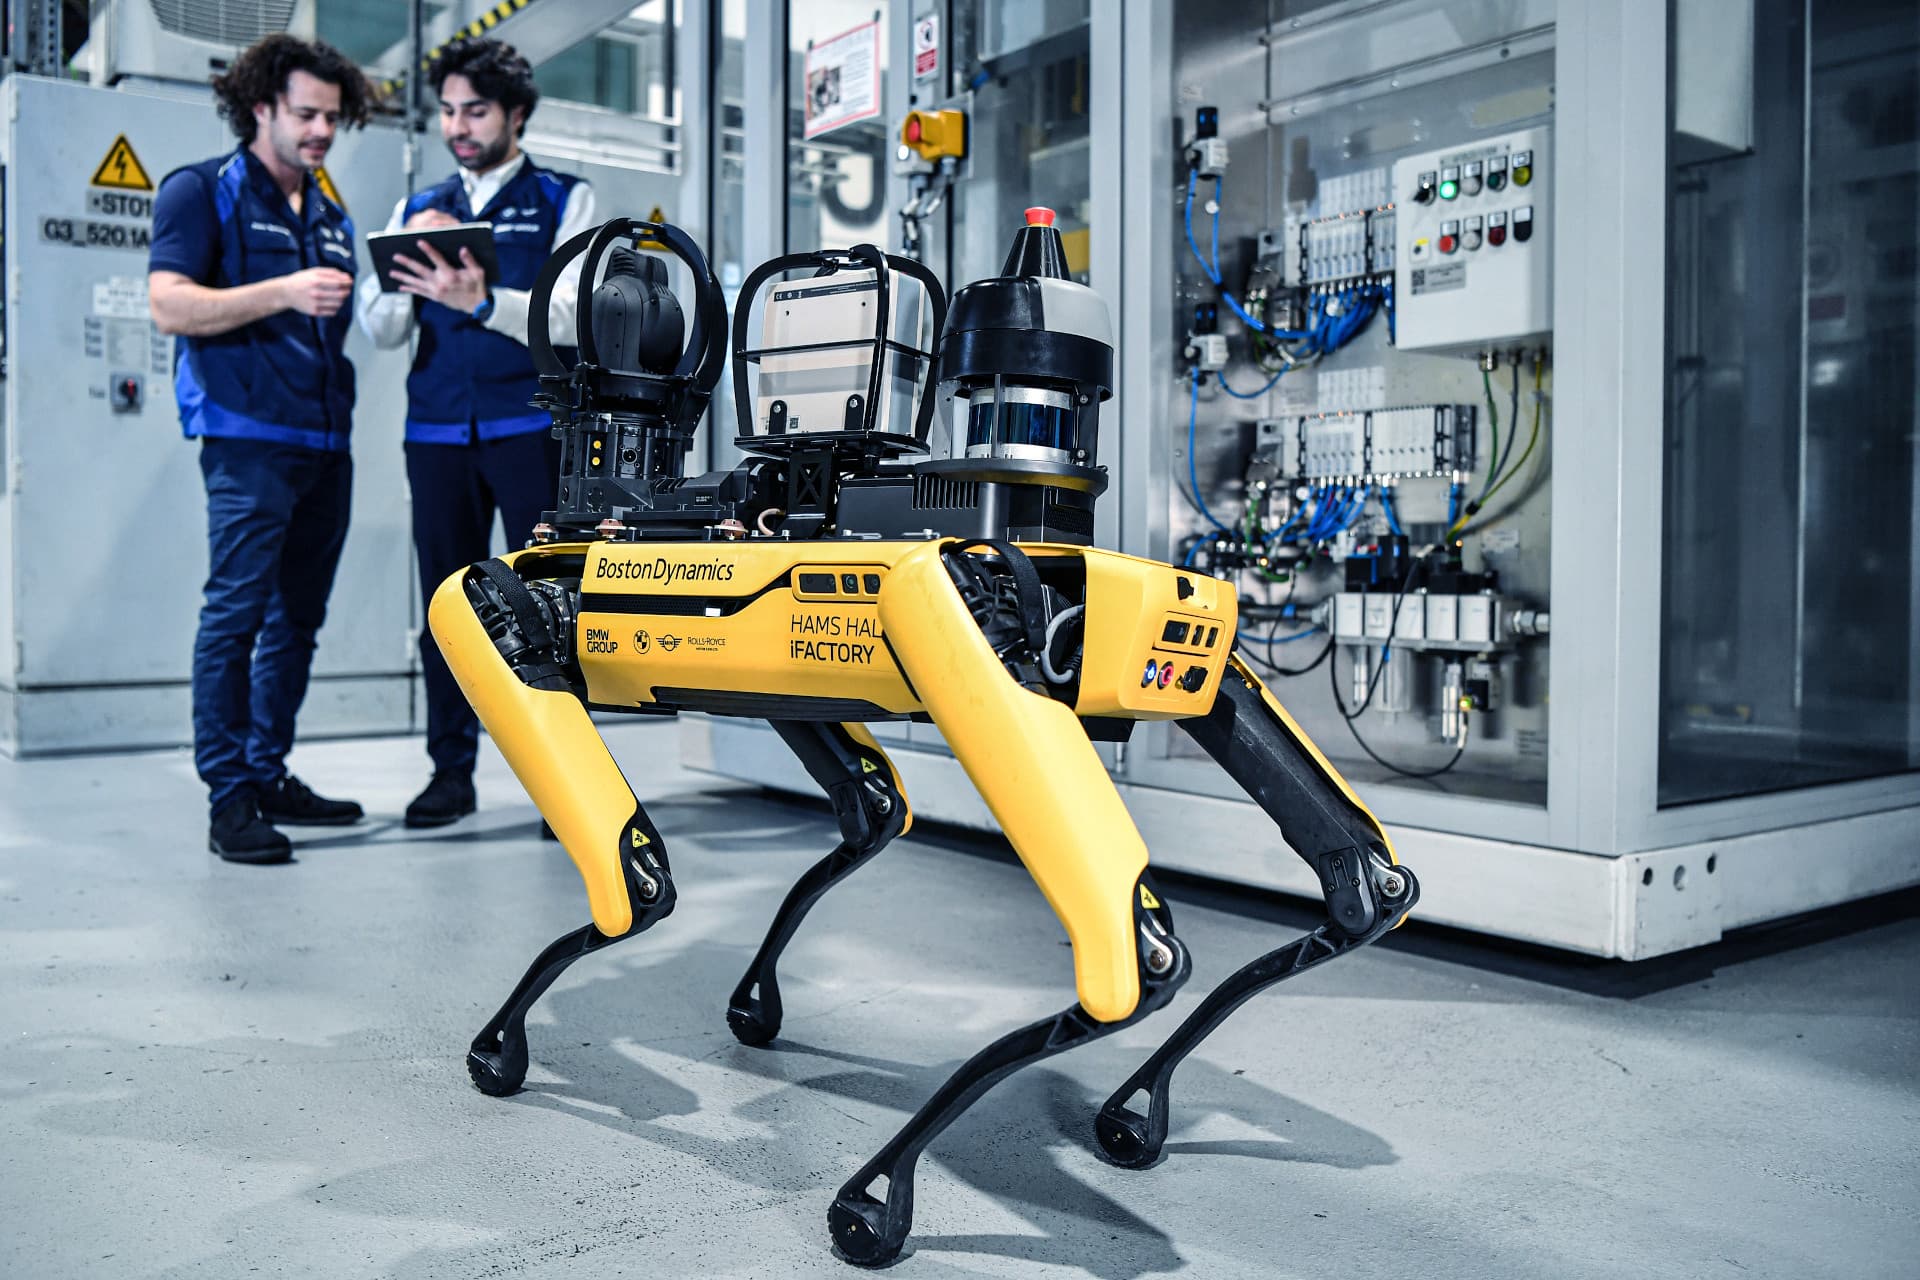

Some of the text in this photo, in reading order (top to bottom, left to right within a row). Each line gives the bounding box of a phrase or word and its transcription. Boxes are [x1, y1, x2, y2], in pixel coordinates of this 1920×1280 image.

[596, 557, 735, 586] BostonDynamics
[791, 613, 841, 636] HAMS
[586, 629, 609, 641] BMW
[687, 636, 726, 647] ROLLS-ROYCE
[587, 641, 618, 654] GROUP
[790, 639, 875, 664] iFACTORY
